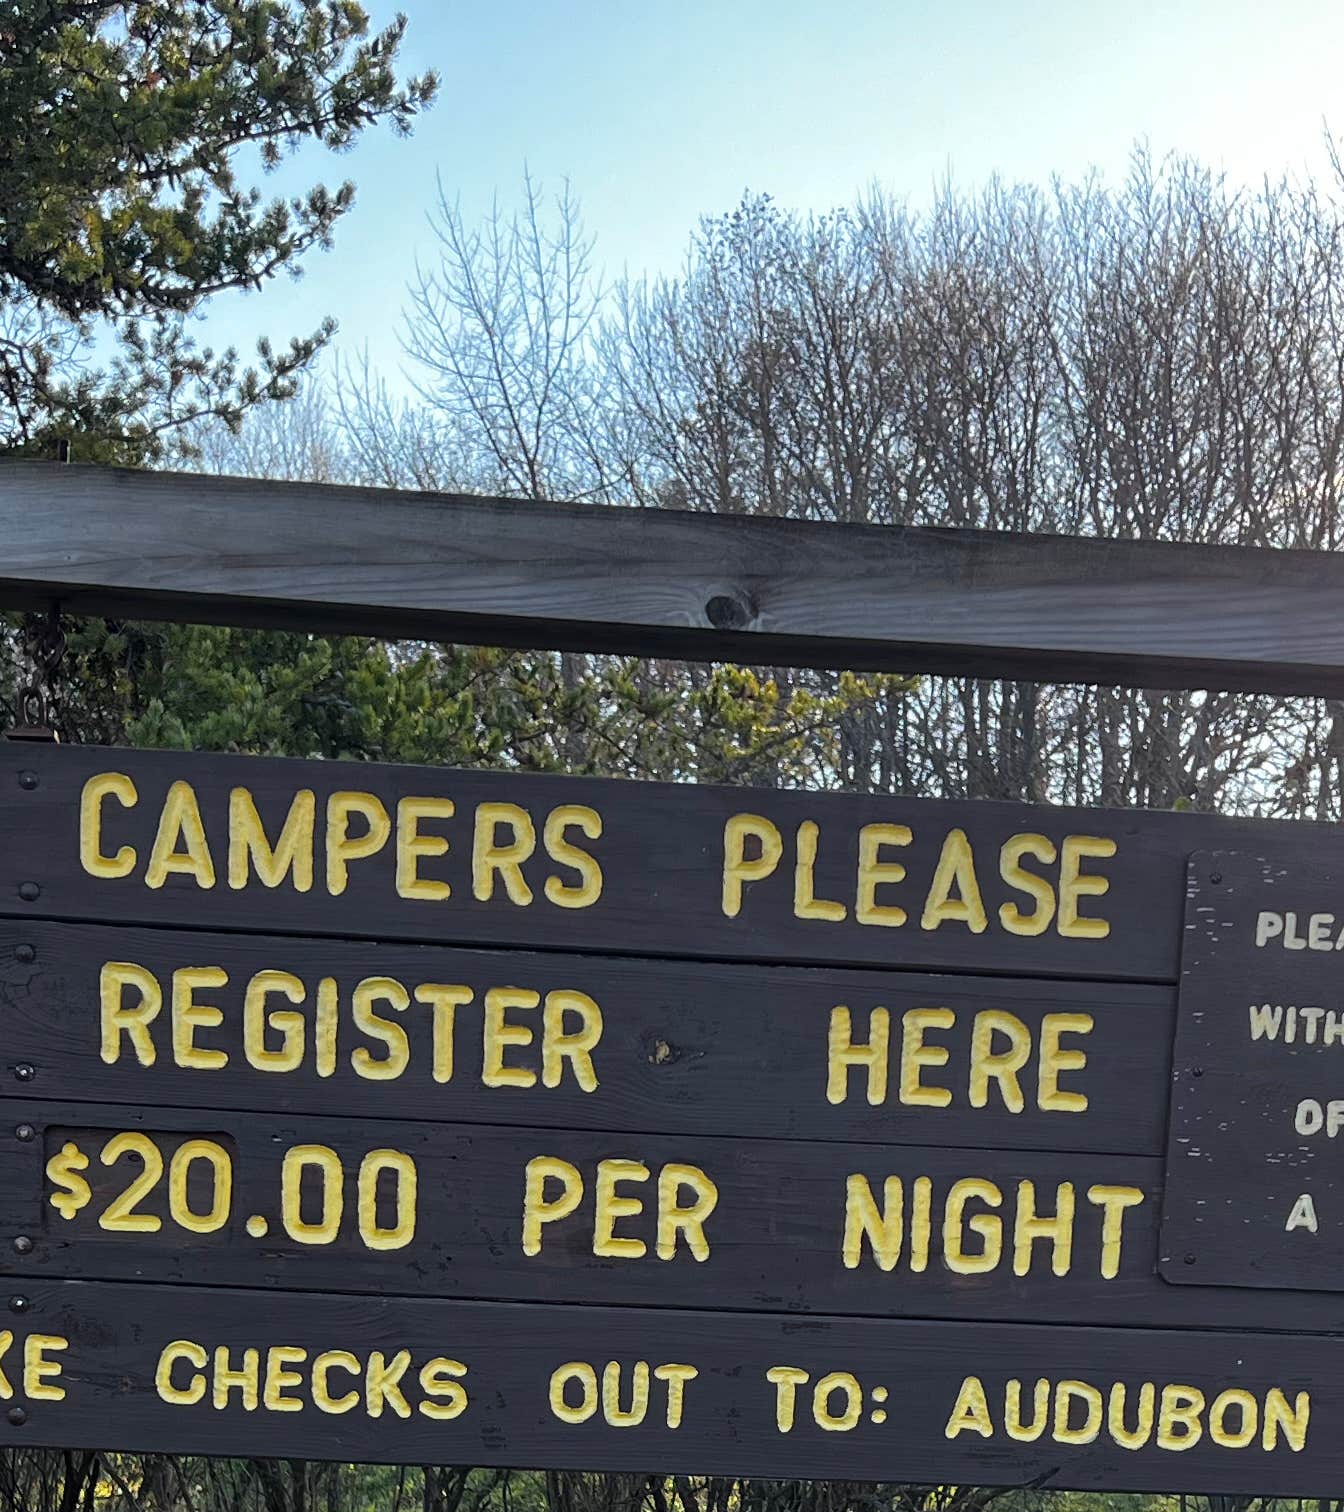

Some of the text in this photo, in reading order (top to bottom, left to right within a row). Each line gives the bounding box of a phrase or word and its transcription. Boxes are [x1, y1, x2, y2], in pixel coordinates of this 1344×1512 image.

[80, 773, 1116, 938] CAMPERS PLEASE
[100, 962, 1093, 1113] REGISTER HERE
[47, 1132, 1144, 1279] $20.00 PER NIGHT
[1285, 1194, 1319, 1233] A
[155, 1341, 468, 1419] CHECKS
[549, 1361, 698, 1428] OUT
[768, 1367, 888, 1432] TO:
[945, 1376, 1309, 1451] AUDUBON
